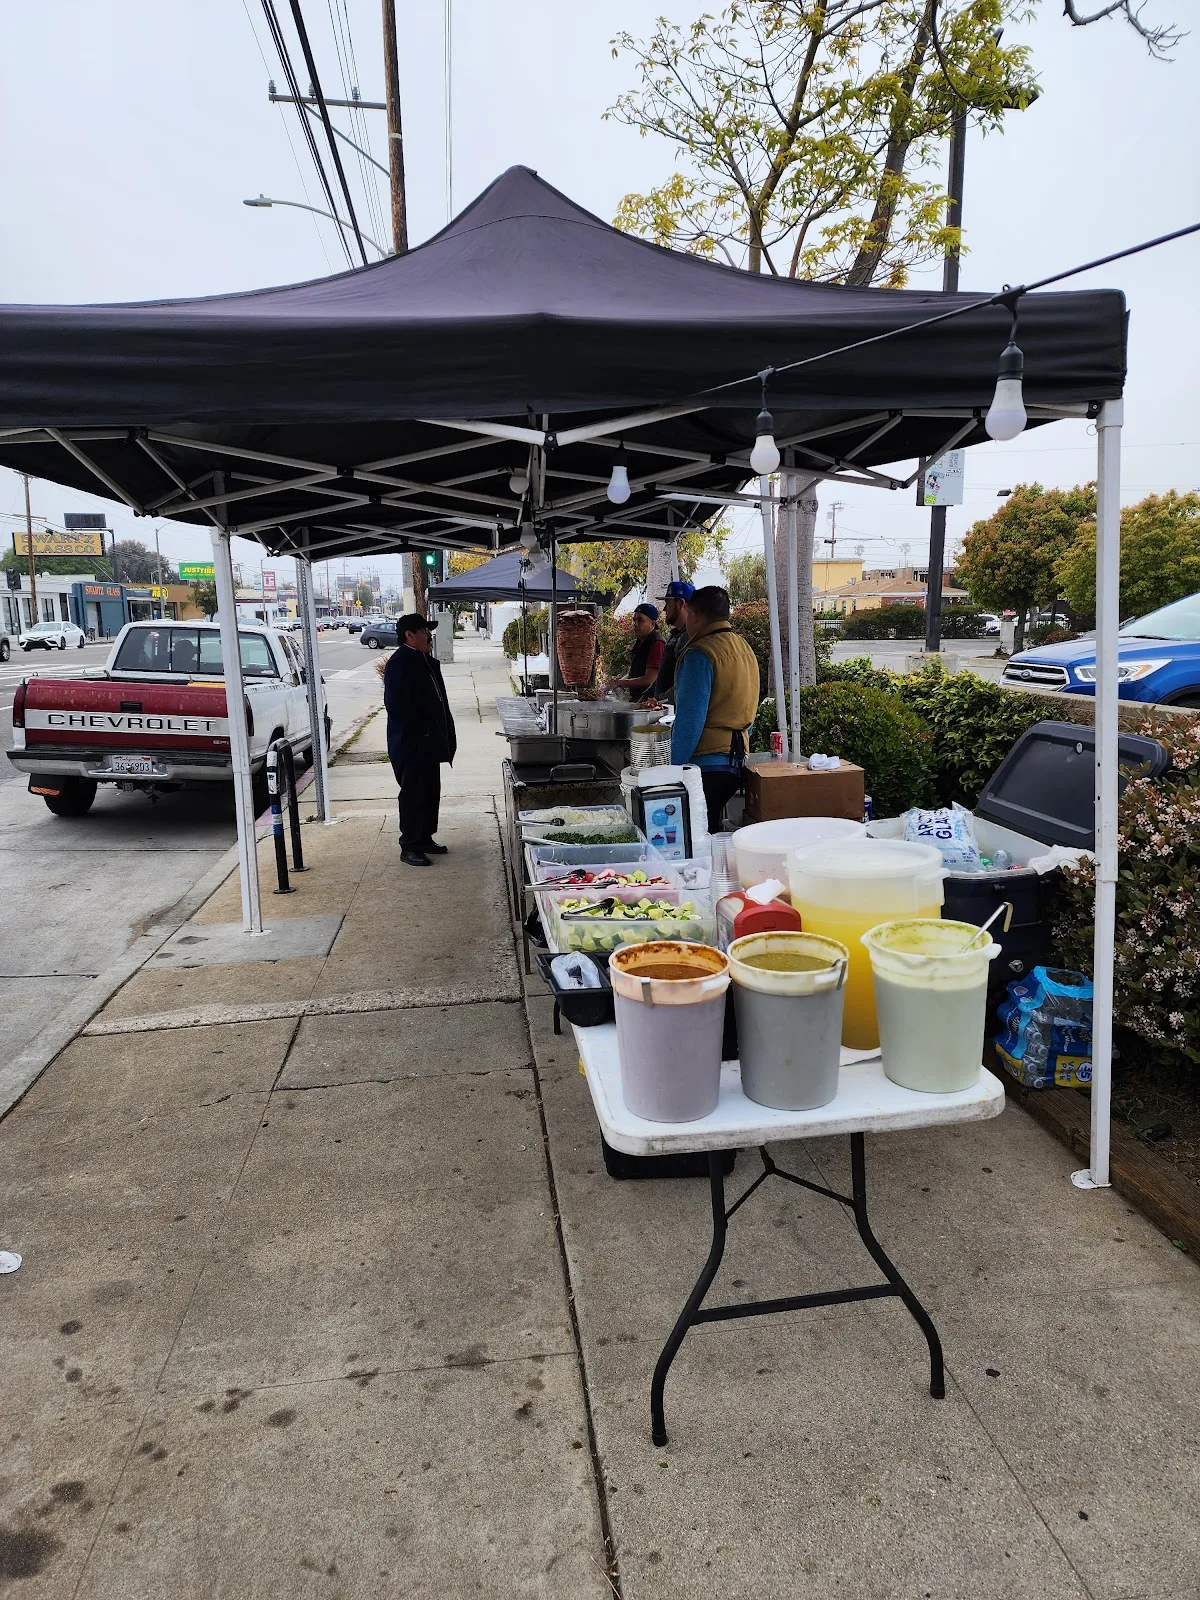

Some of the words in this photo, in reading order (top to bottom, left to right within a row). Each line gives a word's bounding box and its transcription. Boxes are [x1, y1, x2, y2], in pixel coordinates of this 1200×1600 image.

[20, 534, 95, 544] SWARTZ
[21, 545, 74, 554] GLASS
[84, 585, 104, 596] SWARTZ
[106, 586, 121, 597] GLASS
[47, 713, 217, 733] CHEVROLET
